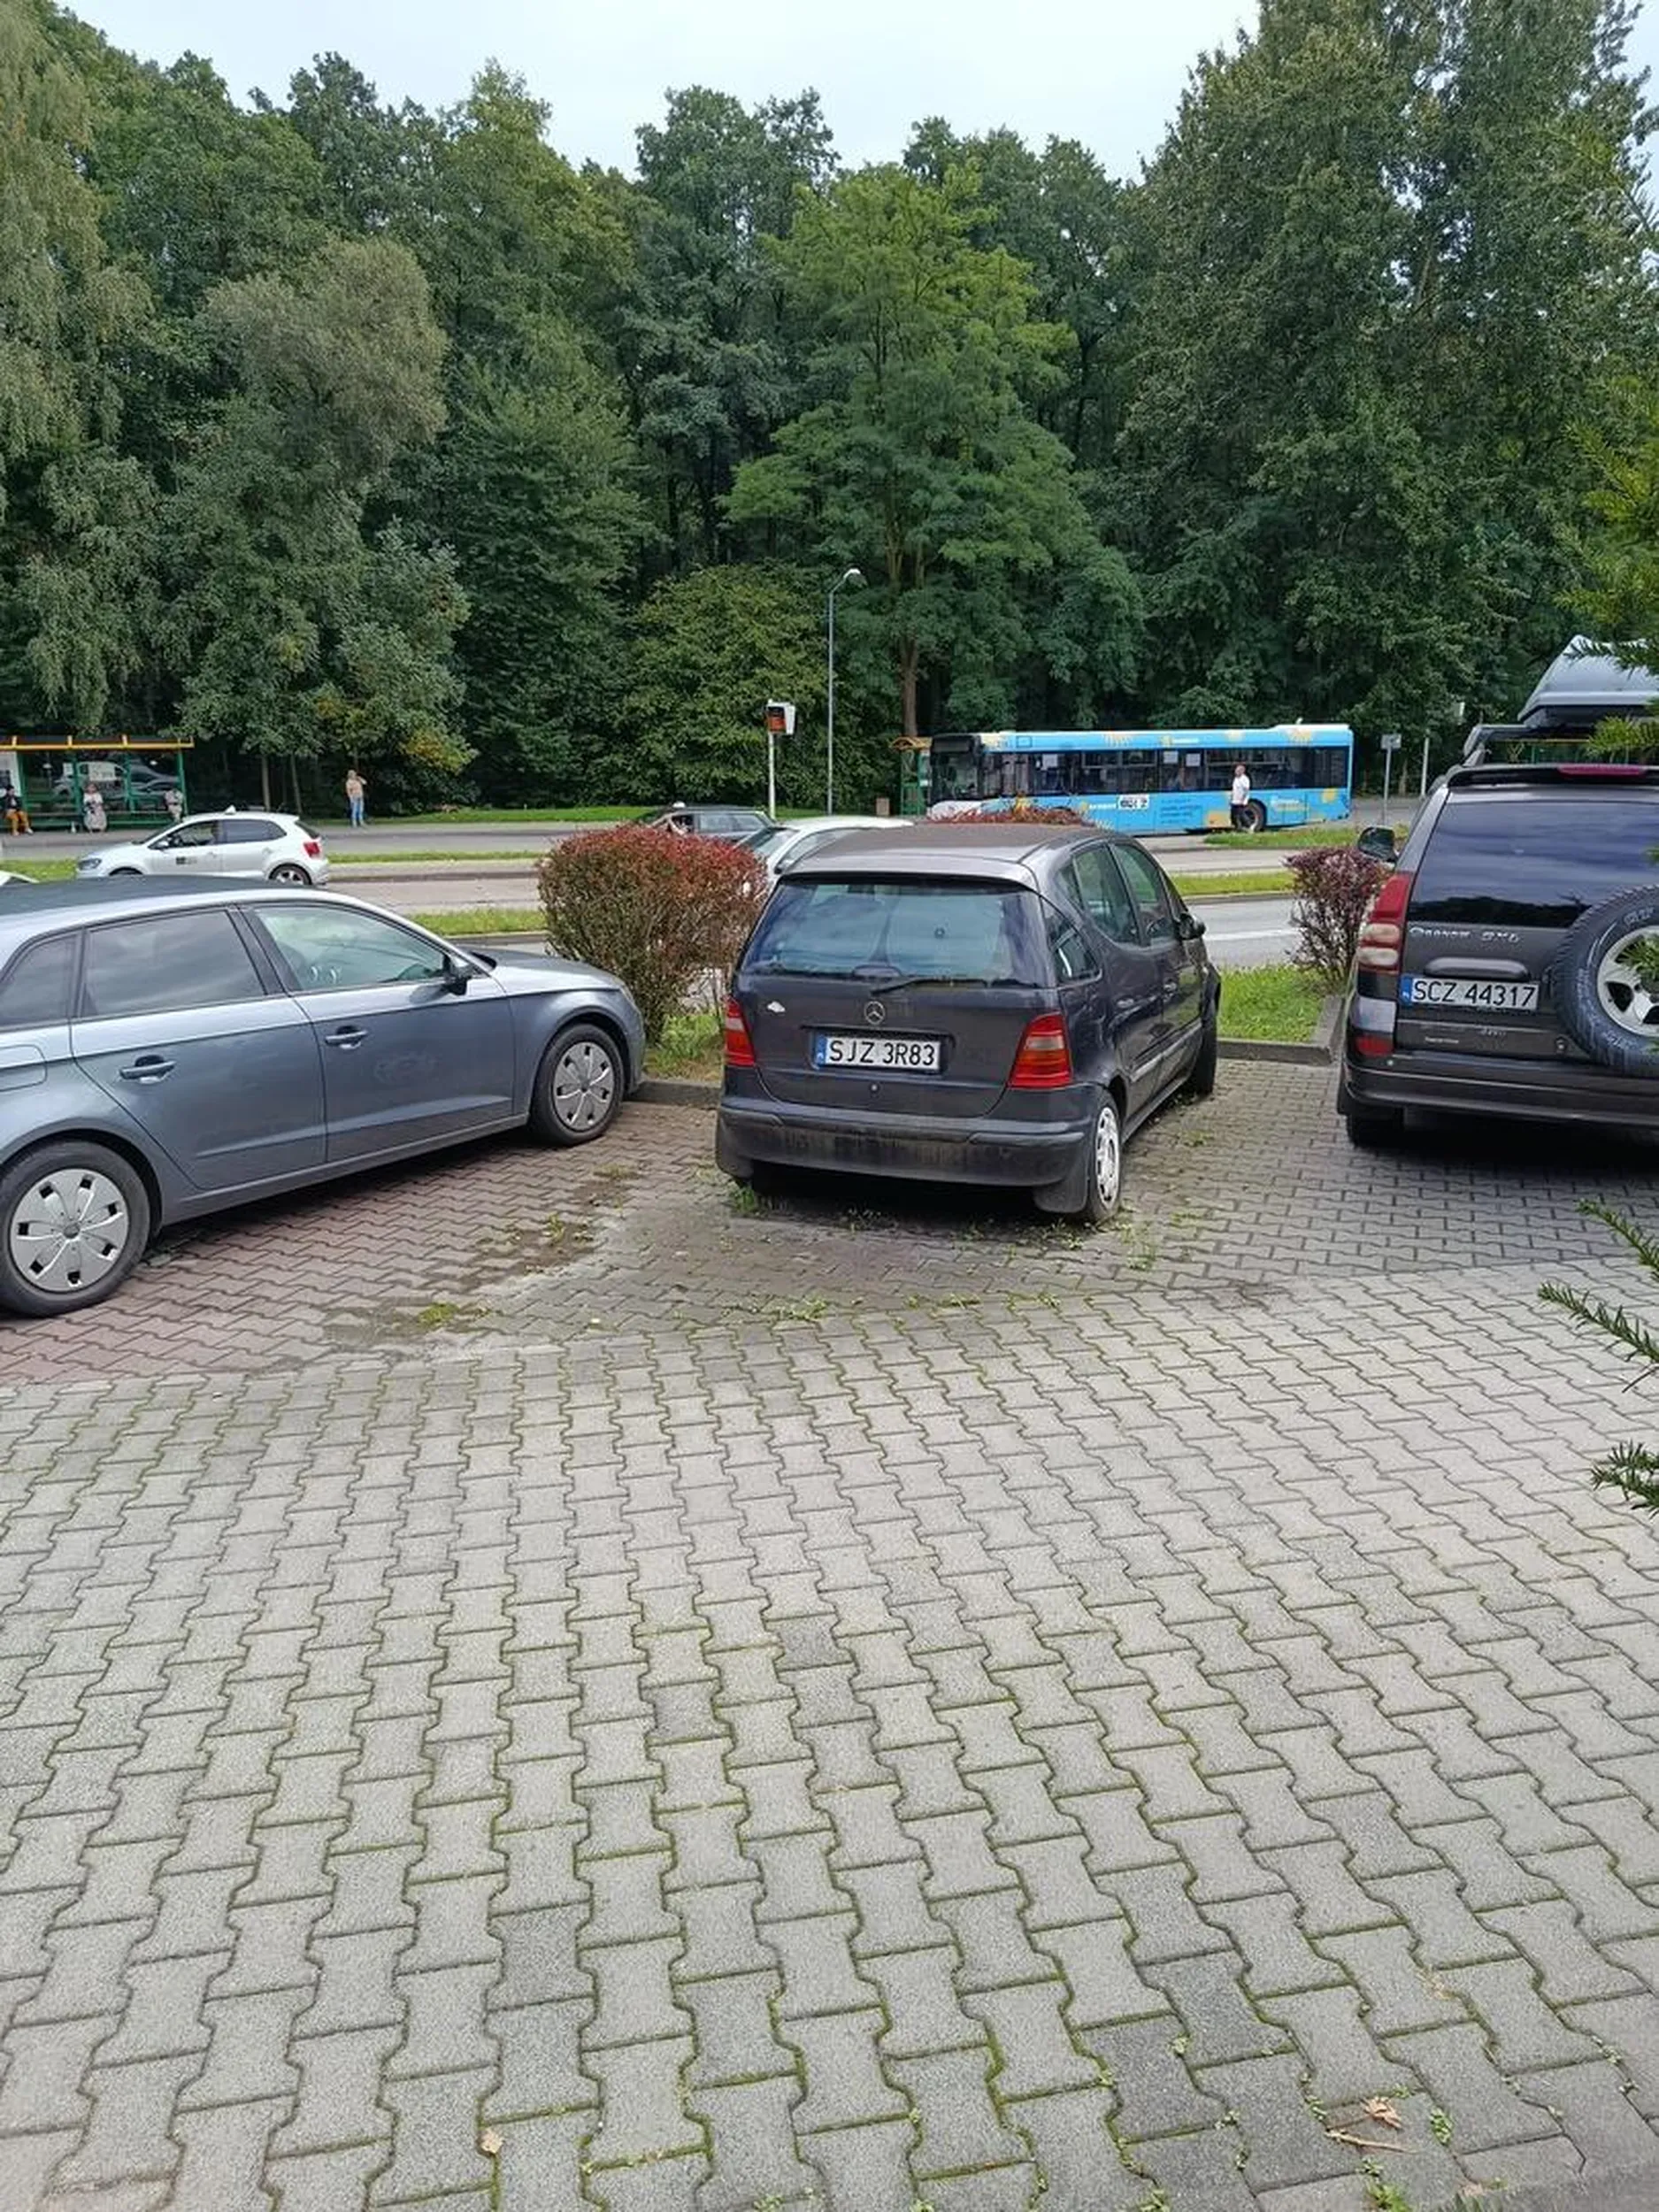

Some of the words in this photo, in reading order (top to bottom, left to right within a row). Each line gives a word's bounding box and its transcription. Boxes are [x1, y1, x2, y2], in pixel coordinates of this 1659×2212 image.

[1413, 980, 1457, 1002] SCZ
[1464, 983, 1536, 1007] 44317
[829, 1040, 875, 1063] SJZ
[882, 1042, 935, 1065] 3R83
